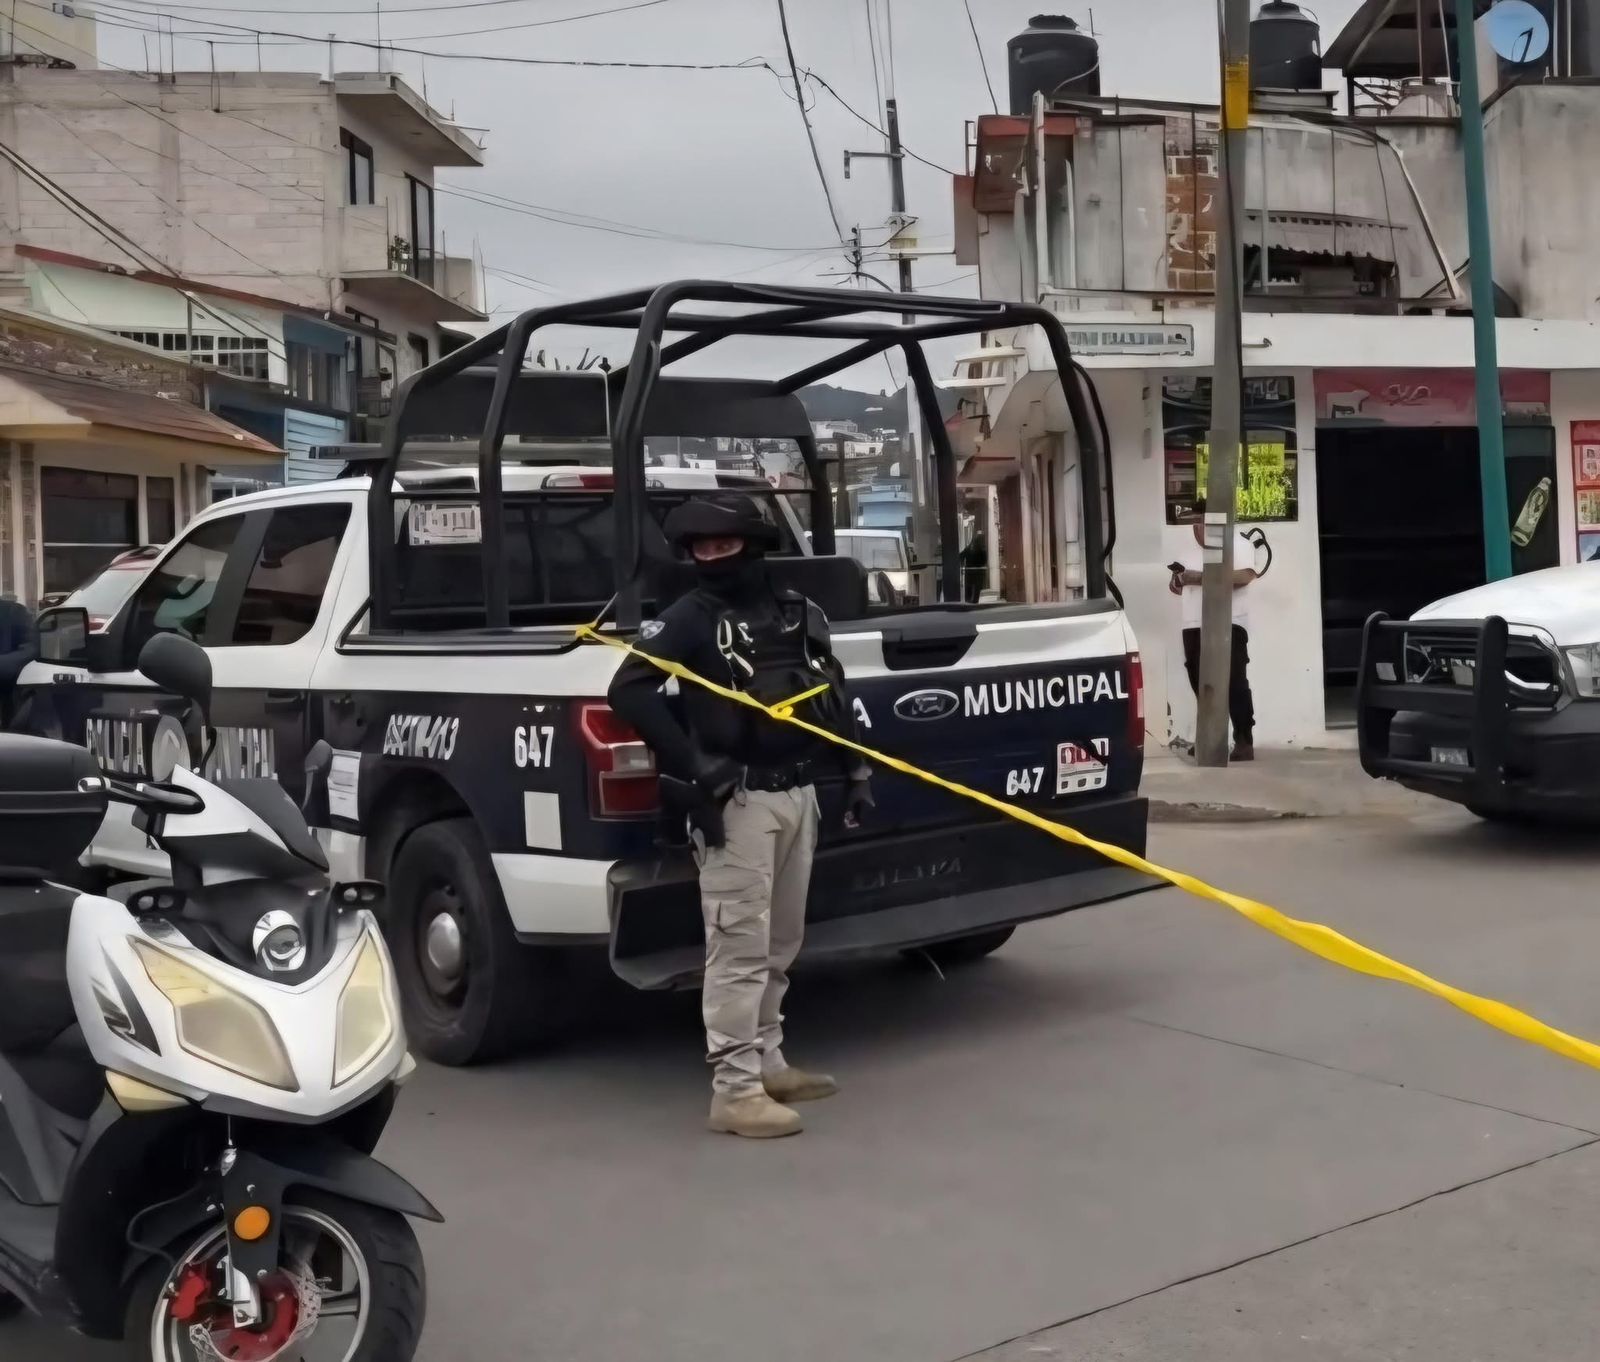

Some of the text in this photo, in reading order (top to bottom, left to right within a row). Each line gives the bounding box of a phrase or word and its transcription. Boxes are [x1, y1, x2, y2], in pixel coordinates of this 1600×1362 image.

[964, 670, 1130, 718] MUNICIPAL
[514, 725, 555, 768] 647
[1006, 766, 1045, 796] 647
